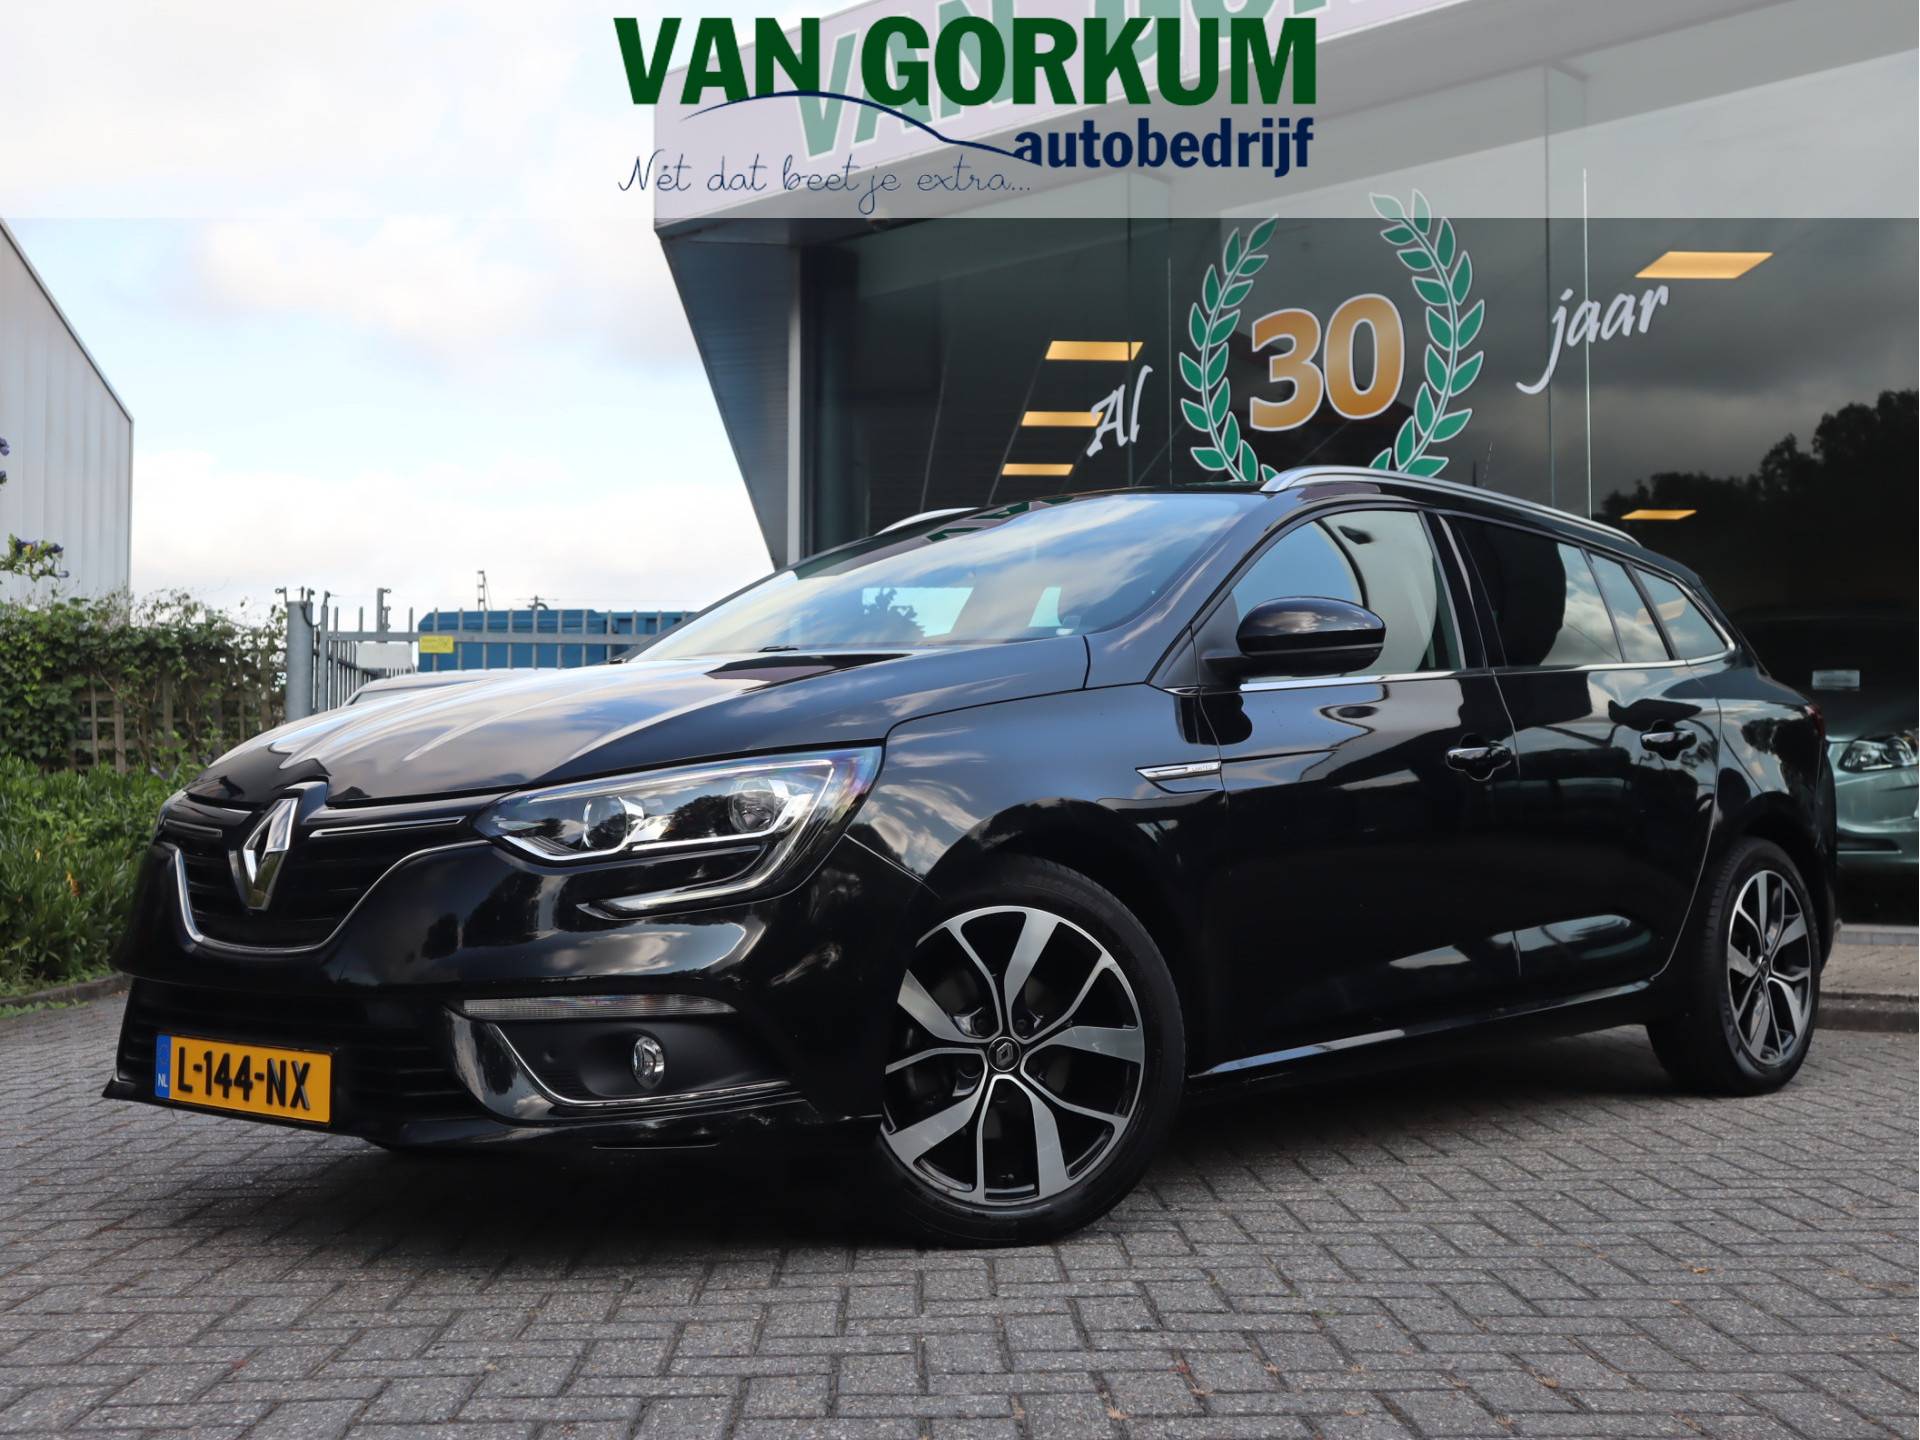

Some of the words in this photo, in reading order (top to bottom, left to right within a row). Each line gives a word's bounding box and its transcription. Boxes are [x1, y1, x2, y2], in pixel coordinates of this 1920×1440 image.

[1086, 365, 1153, 457] Al
[1249, 293, 1406, 432] 30
[1516, 285, 1669, 395] jaar
[157, 1073, 169, 1088] NL
[177, 1046, 310, 1110] L-144-NX
